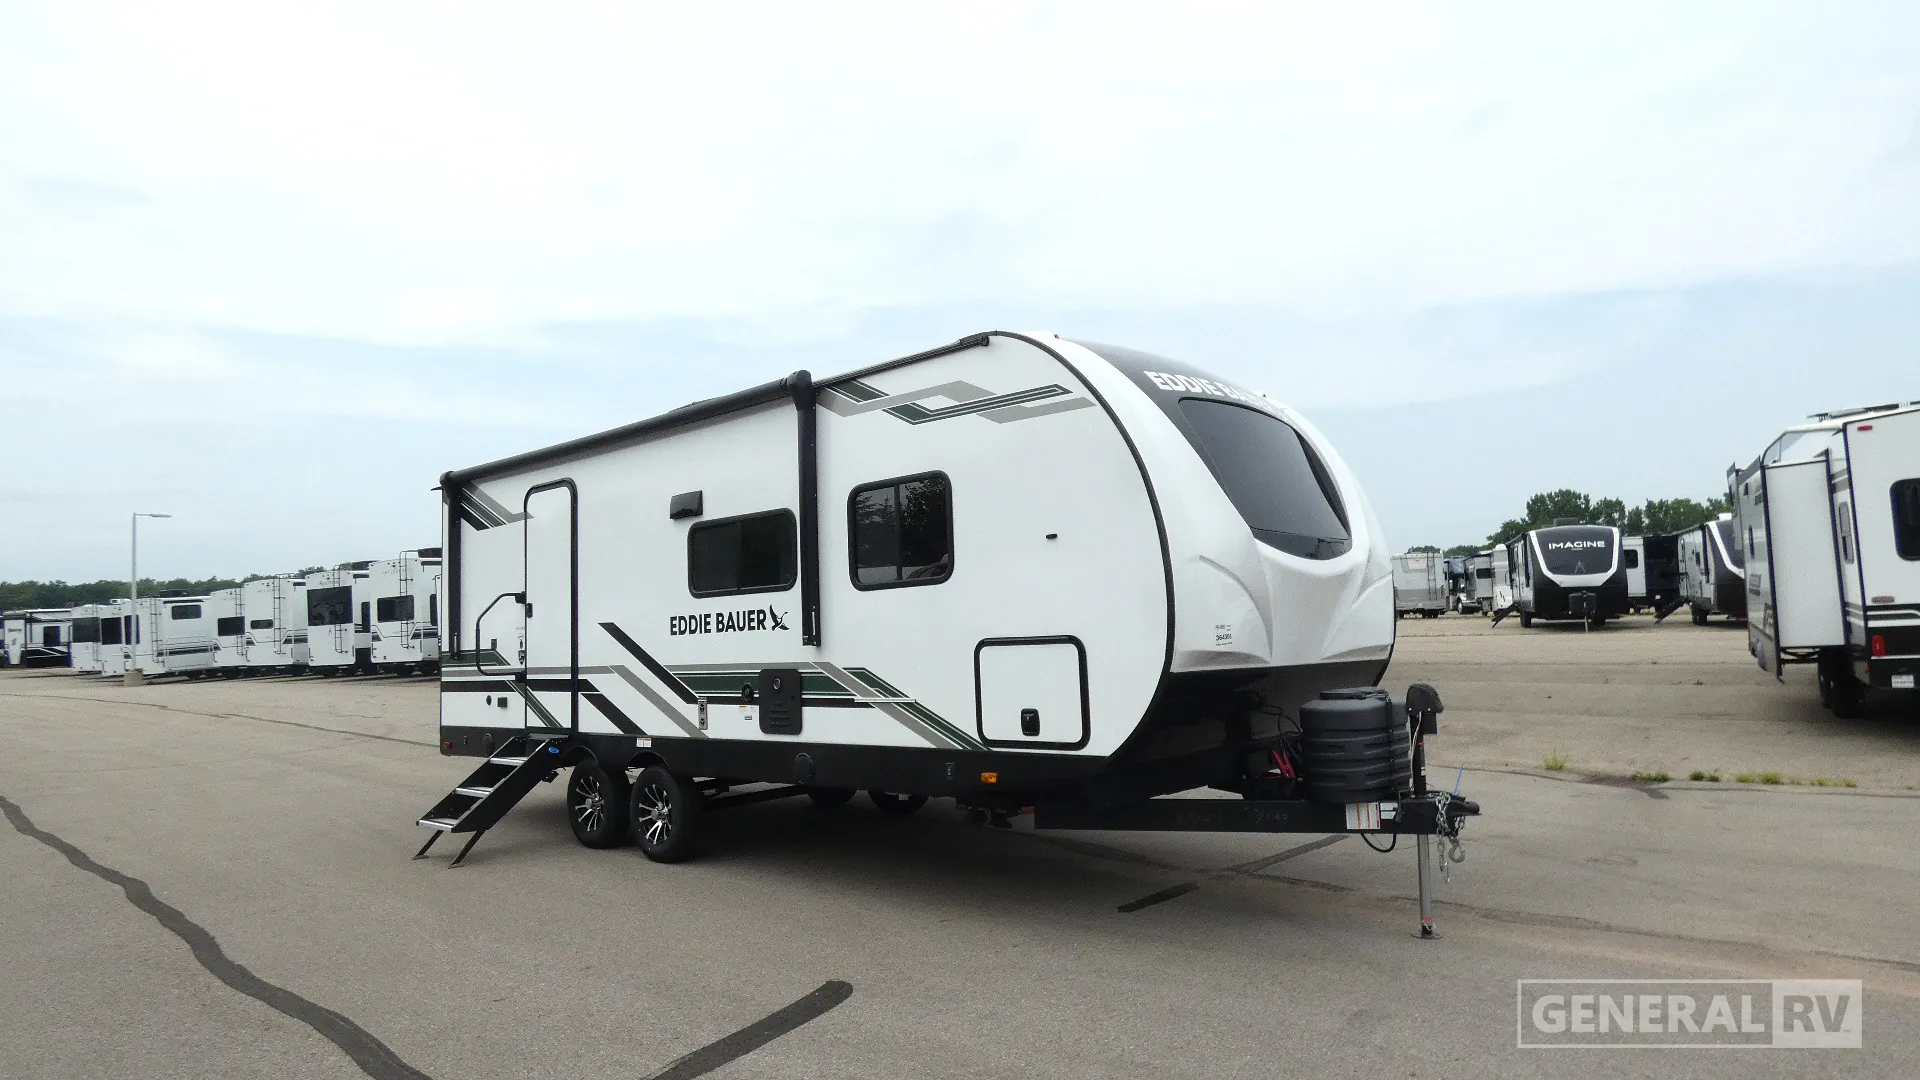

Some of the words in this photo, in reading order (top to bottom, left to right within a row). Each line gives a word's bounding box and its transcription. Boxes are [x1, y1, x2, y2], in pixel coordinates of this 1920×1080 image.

[1143, 370, 1225, 397] EDDIE
[1548, 540, 1606, 550] IMAGINE
[669, 613, 712, 636] EDDIE
[715, 609, 767, 633] BAUER
